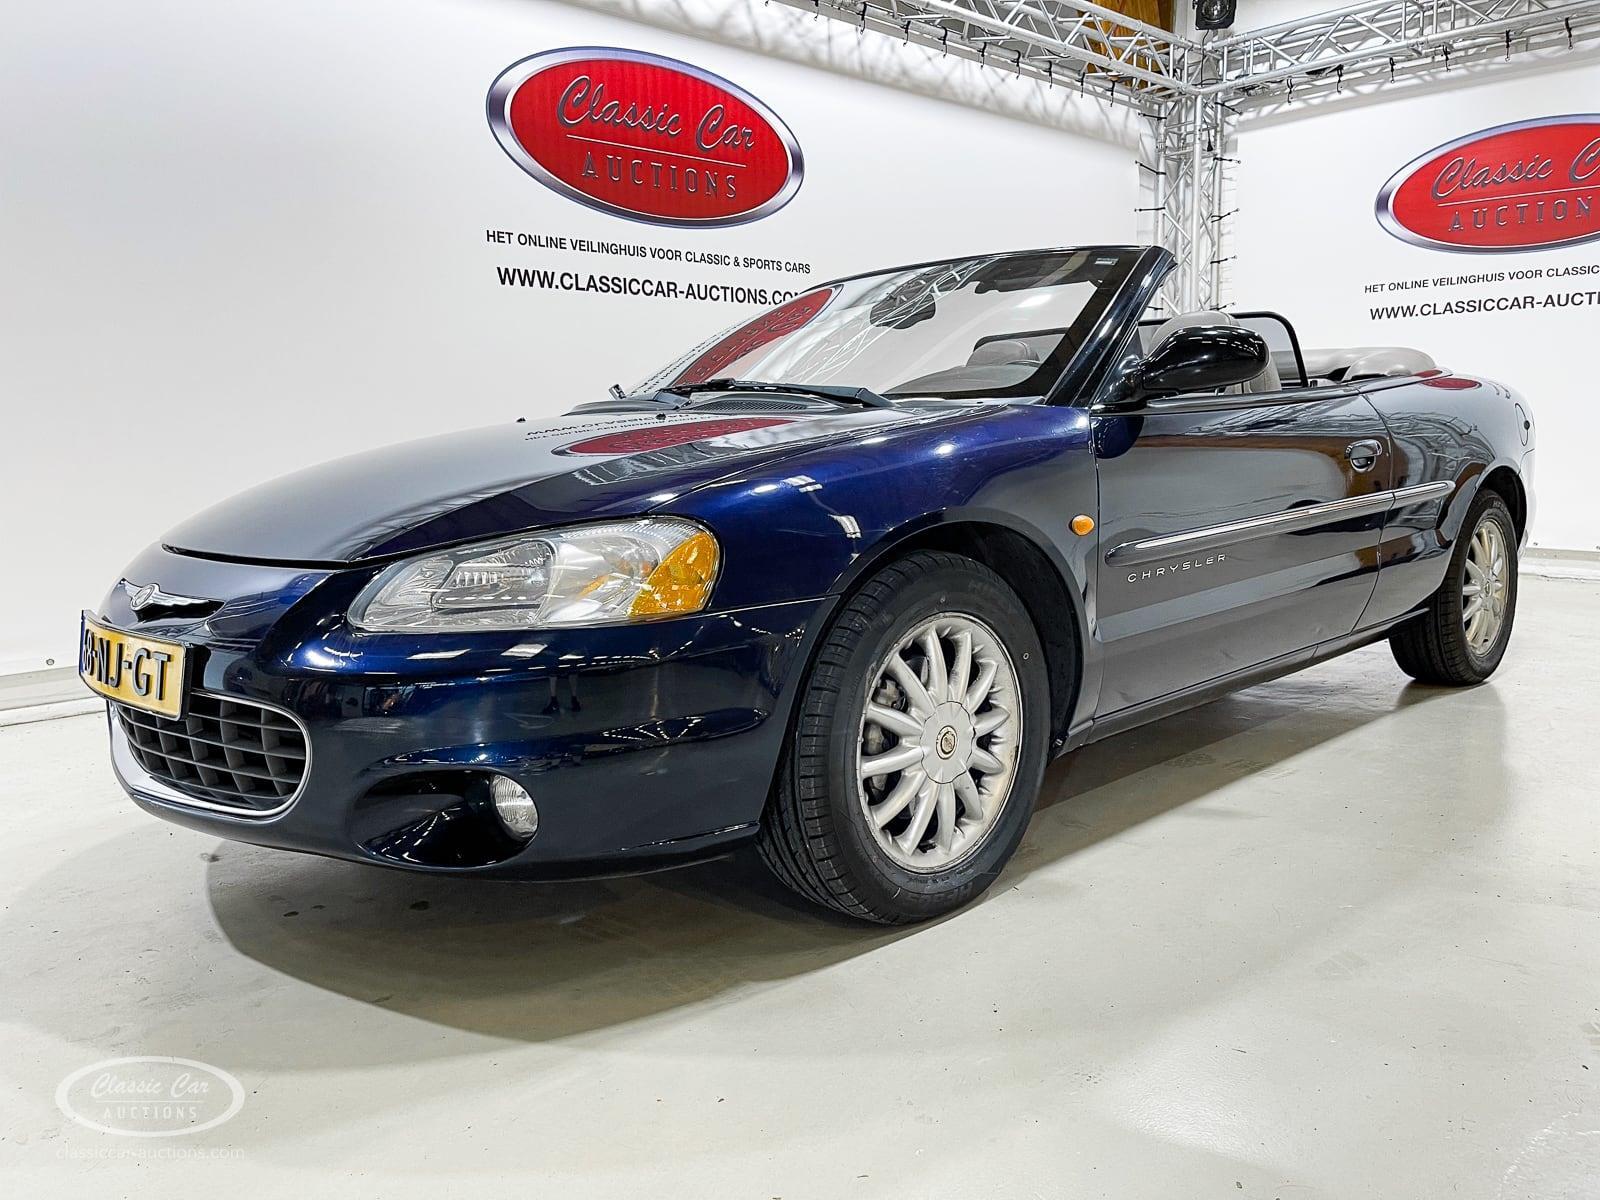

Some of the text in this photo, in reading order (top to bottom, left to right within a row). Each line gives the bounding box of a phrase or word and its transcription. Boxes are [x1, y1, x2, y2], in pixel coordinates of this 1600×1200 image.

[557, 75, 755, 150] Classic Car
[581, 151, 737, 199] AUCTIONS
[1431, 155, 1553, 199] Classic
[486, 229, 811, 274] HET ONLINE VEILINGHUIS VOOR CLASSIC & SPORTS CARS
[496, 266, 801, 306] WWW.CLASSICCAR-AUCTIONS.CO
[1364, 264, 1600, 294] HET ONLINE VEILINGHUIS VOOR CLASSIC
[1127, 554, 1226, 582] CHRYSLER
